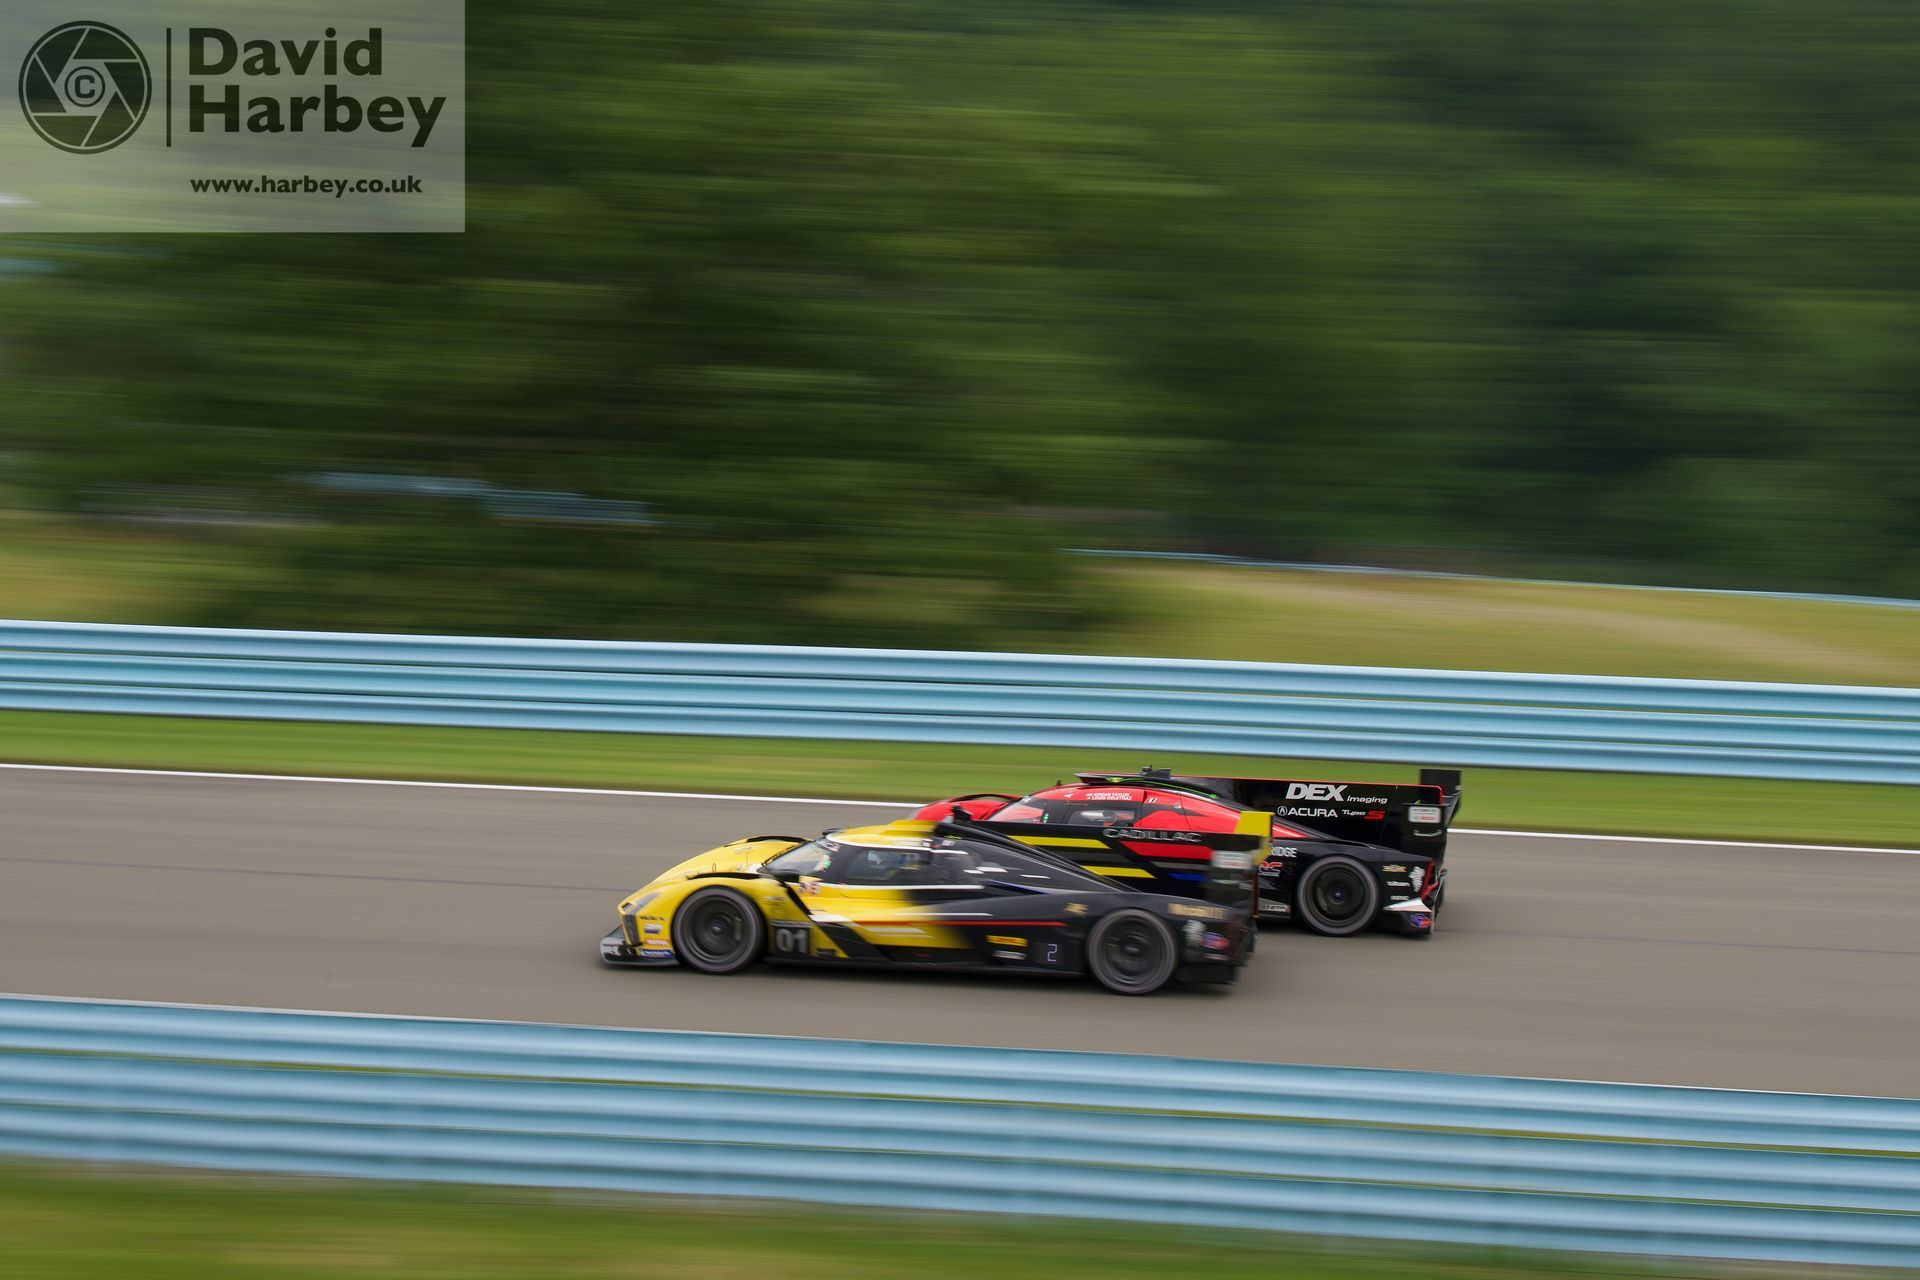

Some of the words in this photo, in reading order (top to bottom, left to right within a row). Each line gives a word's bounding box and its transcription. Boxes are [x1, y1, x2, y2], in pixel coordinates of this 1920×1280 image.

[1285, 783, 1349, 801] DEX
[1347, 795, 1388, 805] imaging
[1287, 807, 1338, 818] ACURA
[1364, 810, 1386, 820] S
[1102, 828, 1202, 842] CADILLAC
[775, 928, 809, 954] 01
